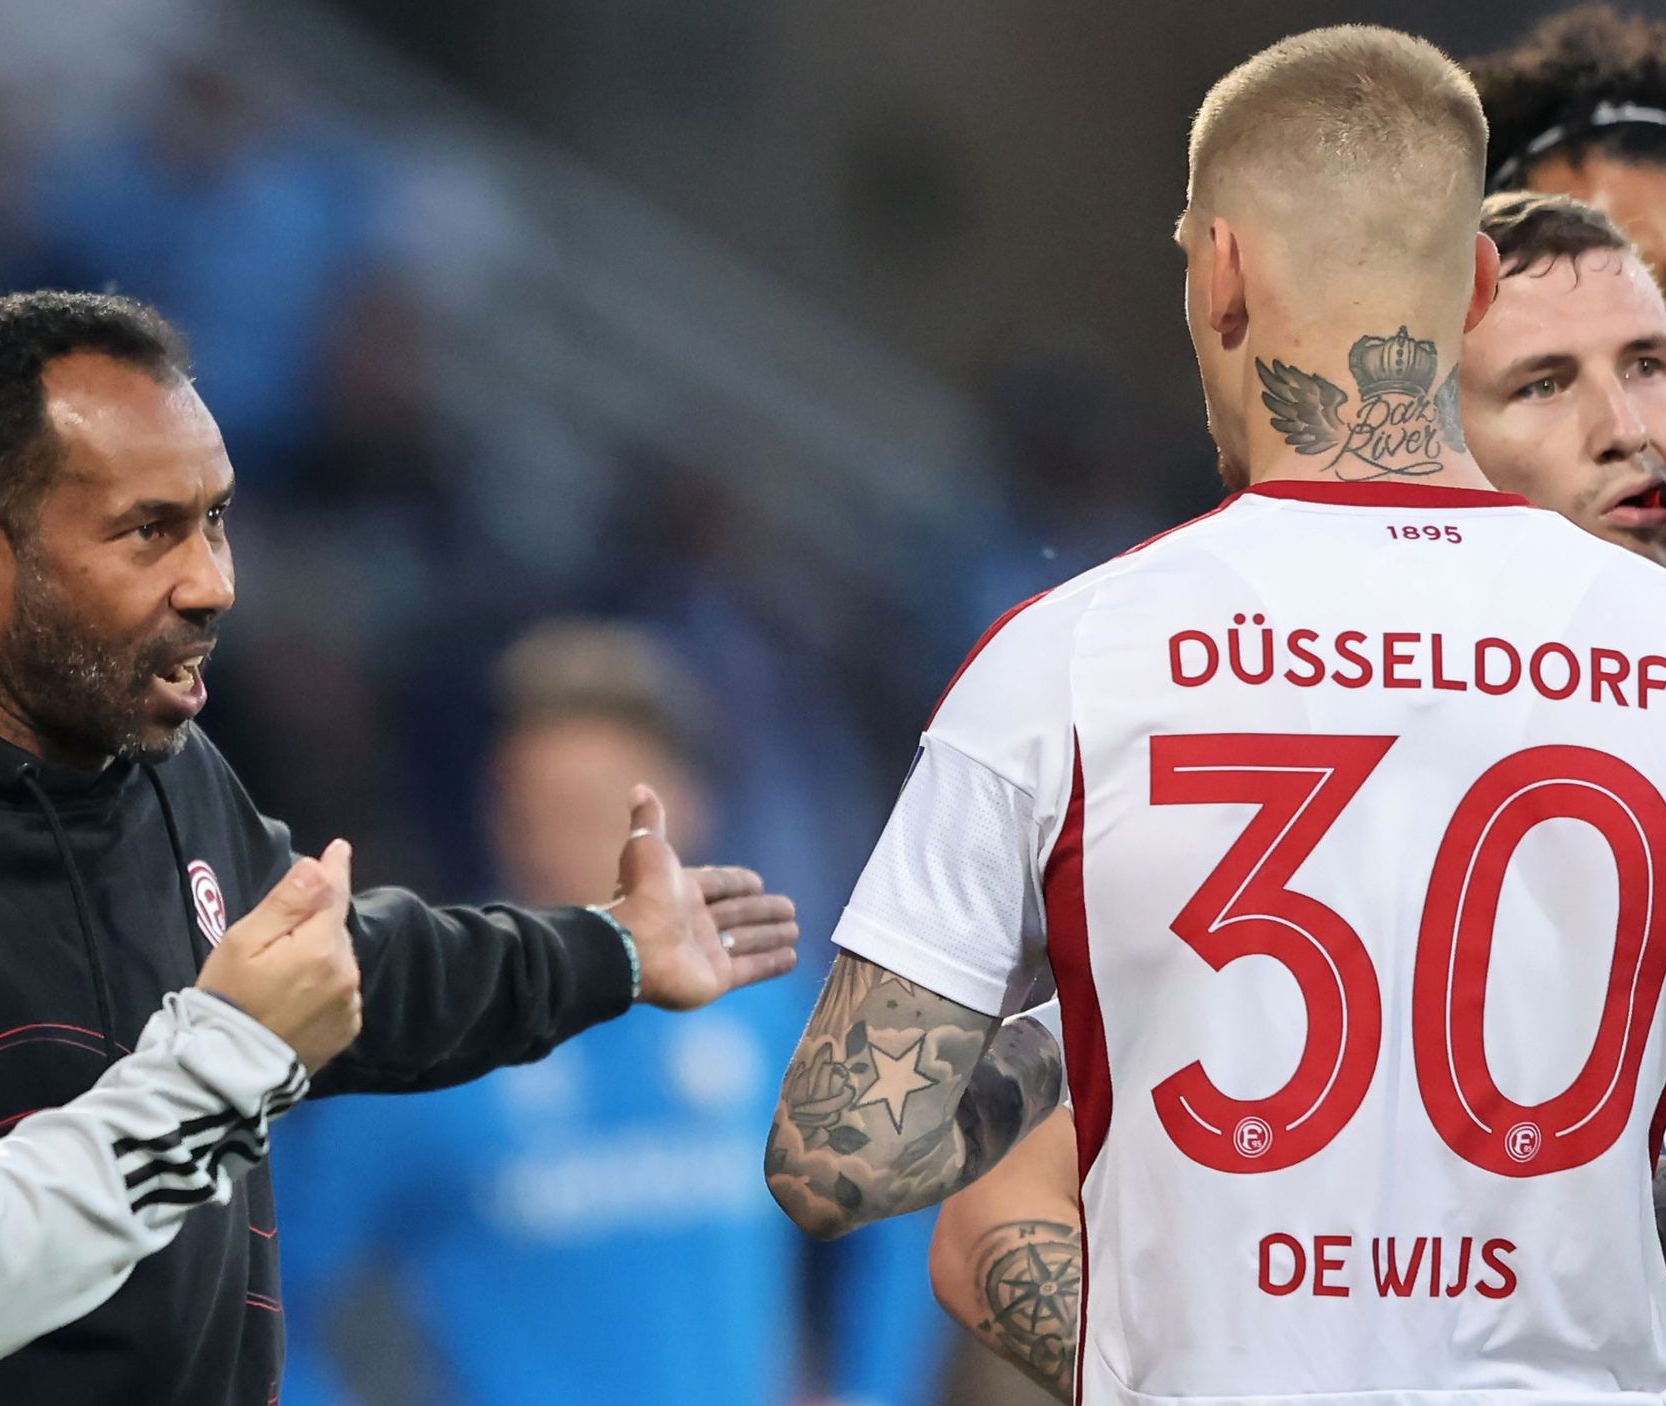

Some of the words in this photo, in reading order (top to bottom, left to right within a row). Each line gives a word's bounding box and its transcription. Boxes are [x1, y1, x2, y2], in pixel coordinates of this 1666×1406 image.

[1319, 422, 1443, 481] River
[1386, 524, 1463, 544] 1895
[1257, 1232, 1351, 1298] DE
[1372, 1235, 1519, 1300] WIJS
